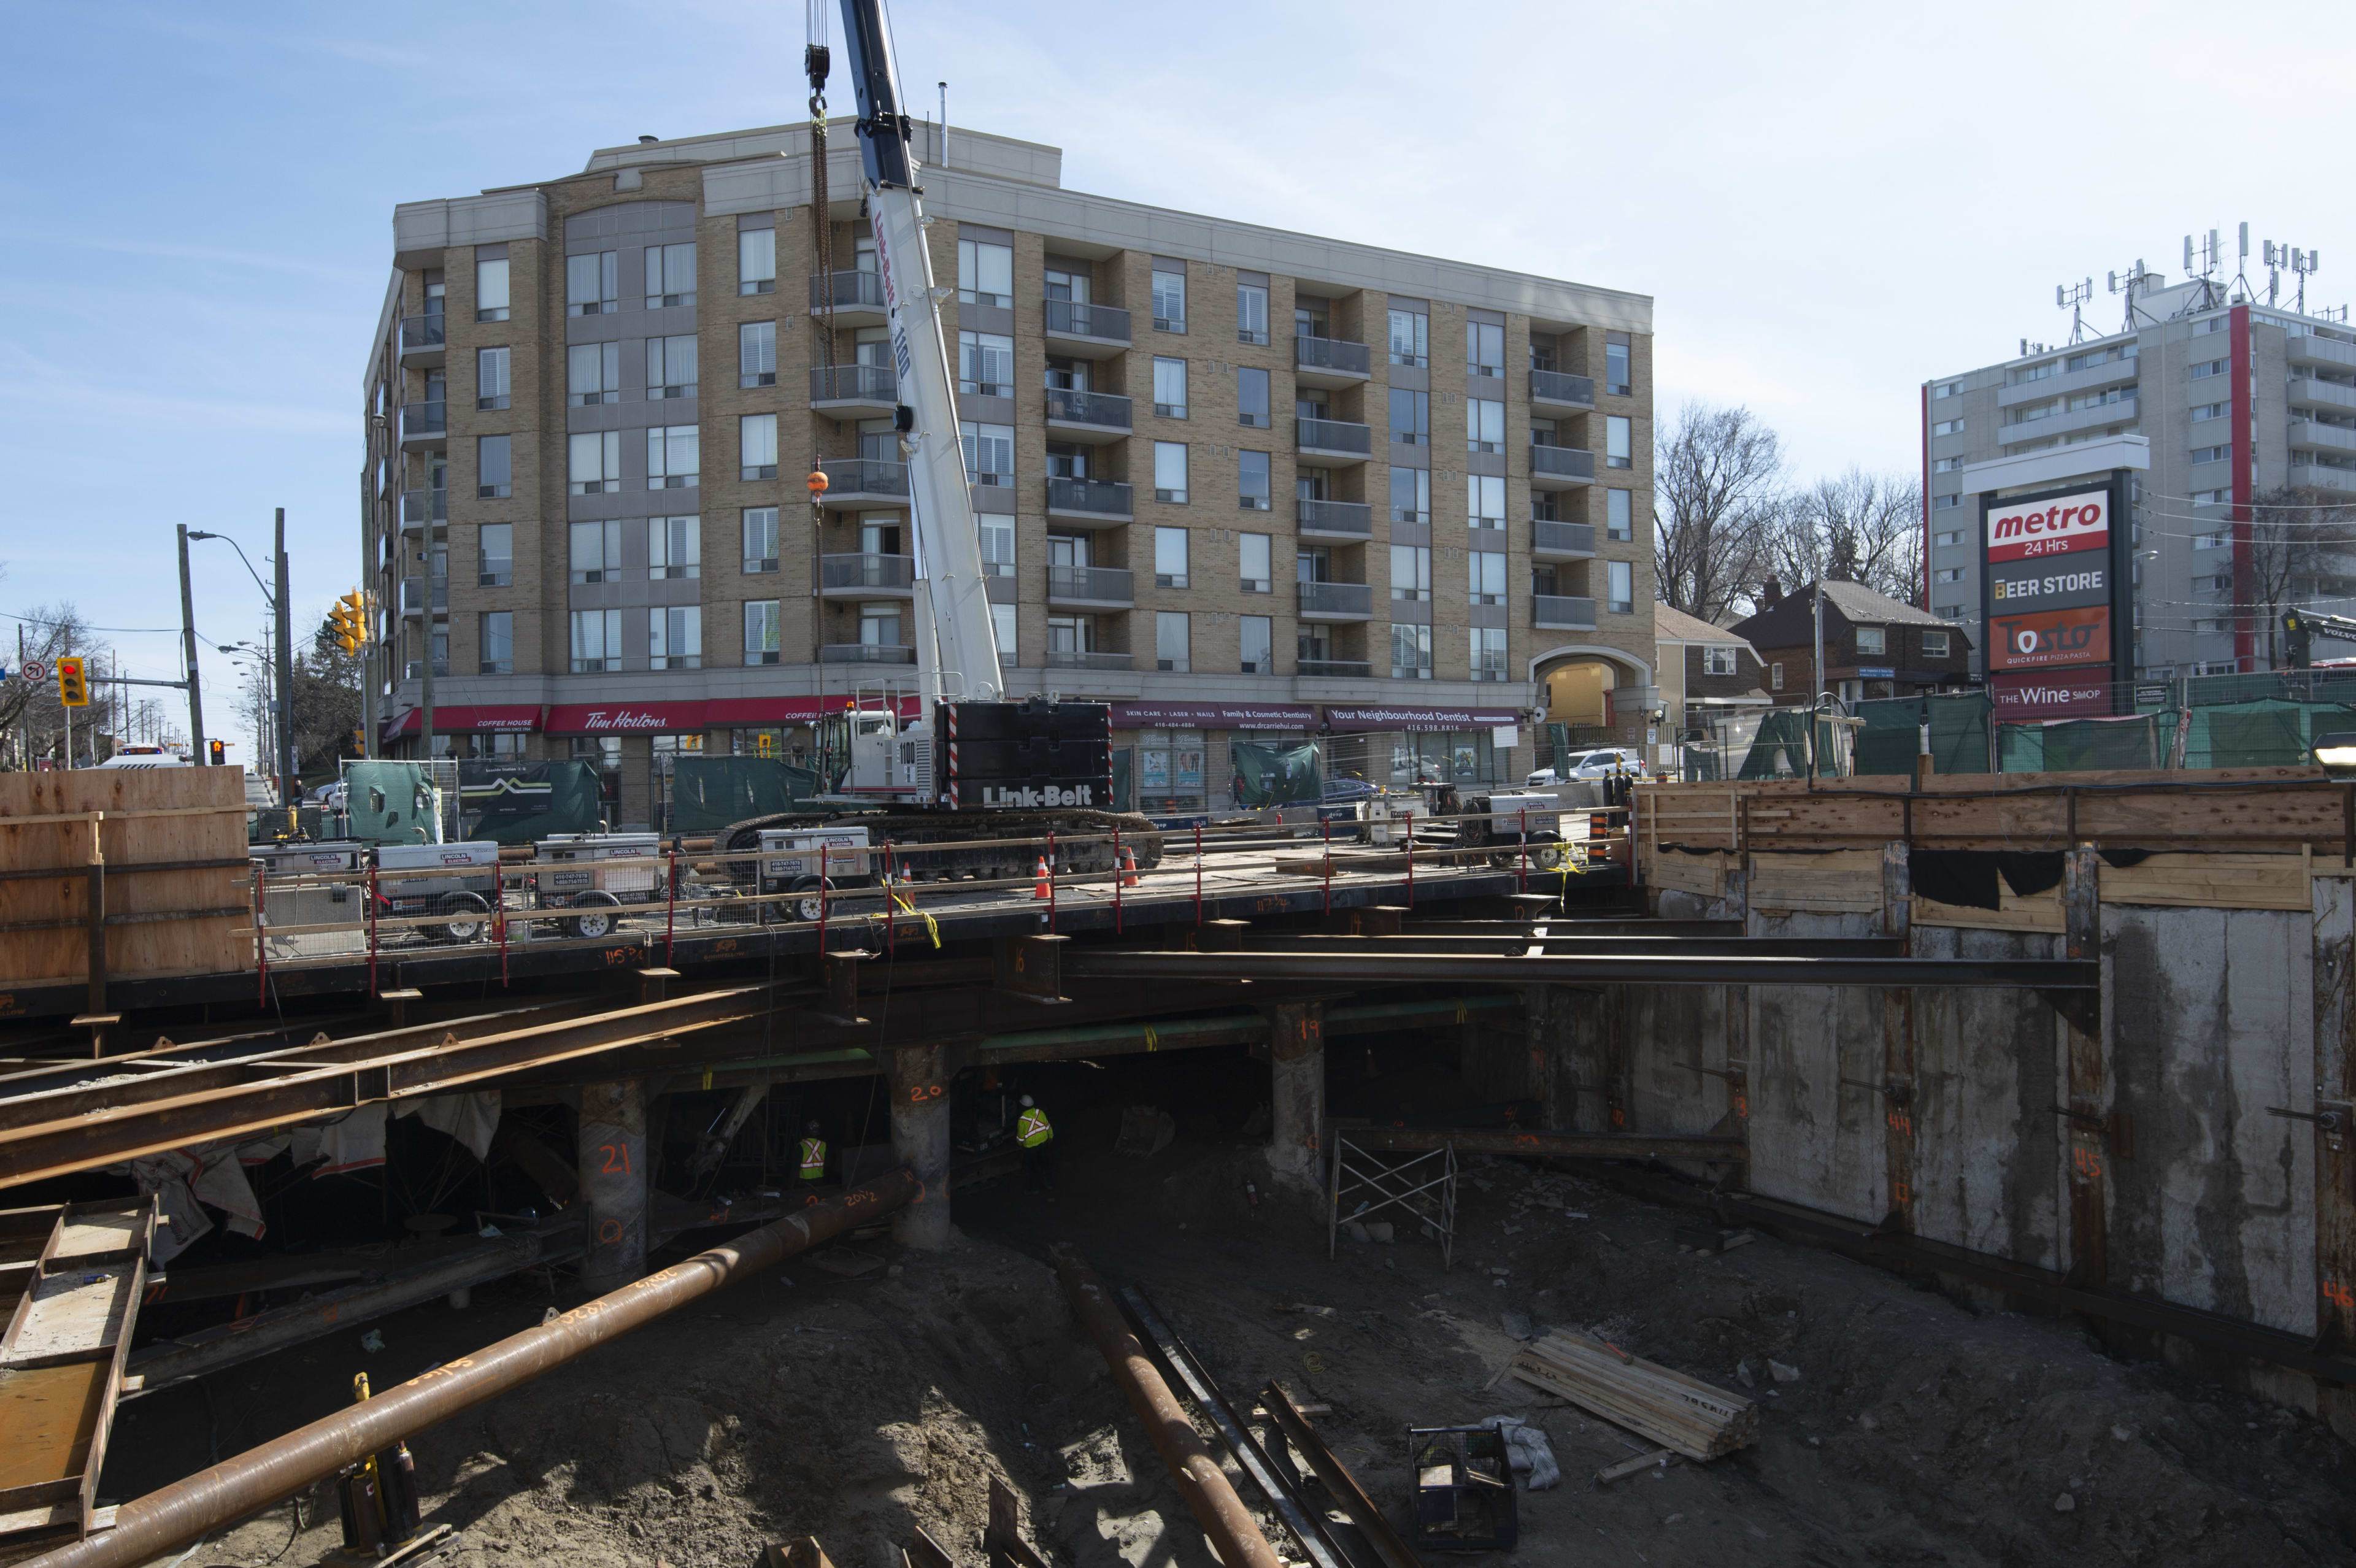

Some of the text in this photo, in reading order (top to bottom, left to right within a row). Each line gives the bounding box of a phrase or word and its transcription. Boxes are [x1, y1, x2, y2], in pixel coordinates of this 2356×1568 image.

[875, 210, 895, 307] Link-Belt
[895, 327, 910, 380] 1100
[1995, 504, 2101, 539] metro
[2025, 539, 2068, 555] 24 Hrs
[1995, 571, 2103, 600] BEER STORE
[1998, 620, 2100, 655] Tosto
[2007, 655, 2048, 664] QUICKFIRE
[2000, 694, 2019, 704] THE
[2020, 687, 2070, 705] Wine
[585, 710, 666, 729] Tim Hortons
[1222, 710, 1244, 719] Family
[1283, 712, 1312, 720] Dentistry
[1331, 709, 1471, 723] Your Neighbourhood Dentist
[899, 742, 915, 764] 1100
[983, 785, 1092, 809] Link-Belt
[1015, 947, 1025, 973] 16
[1301, 1020, 1319, 1041] 19
[909, 1085, 942, 1102] 20
[1888, 1113, 1911, 1137] 44
[599, 1143, 631, 1175] 21
[2074, 1147, 2101, 1177] 45
[2323, 1280, 2355, 1308] 46
